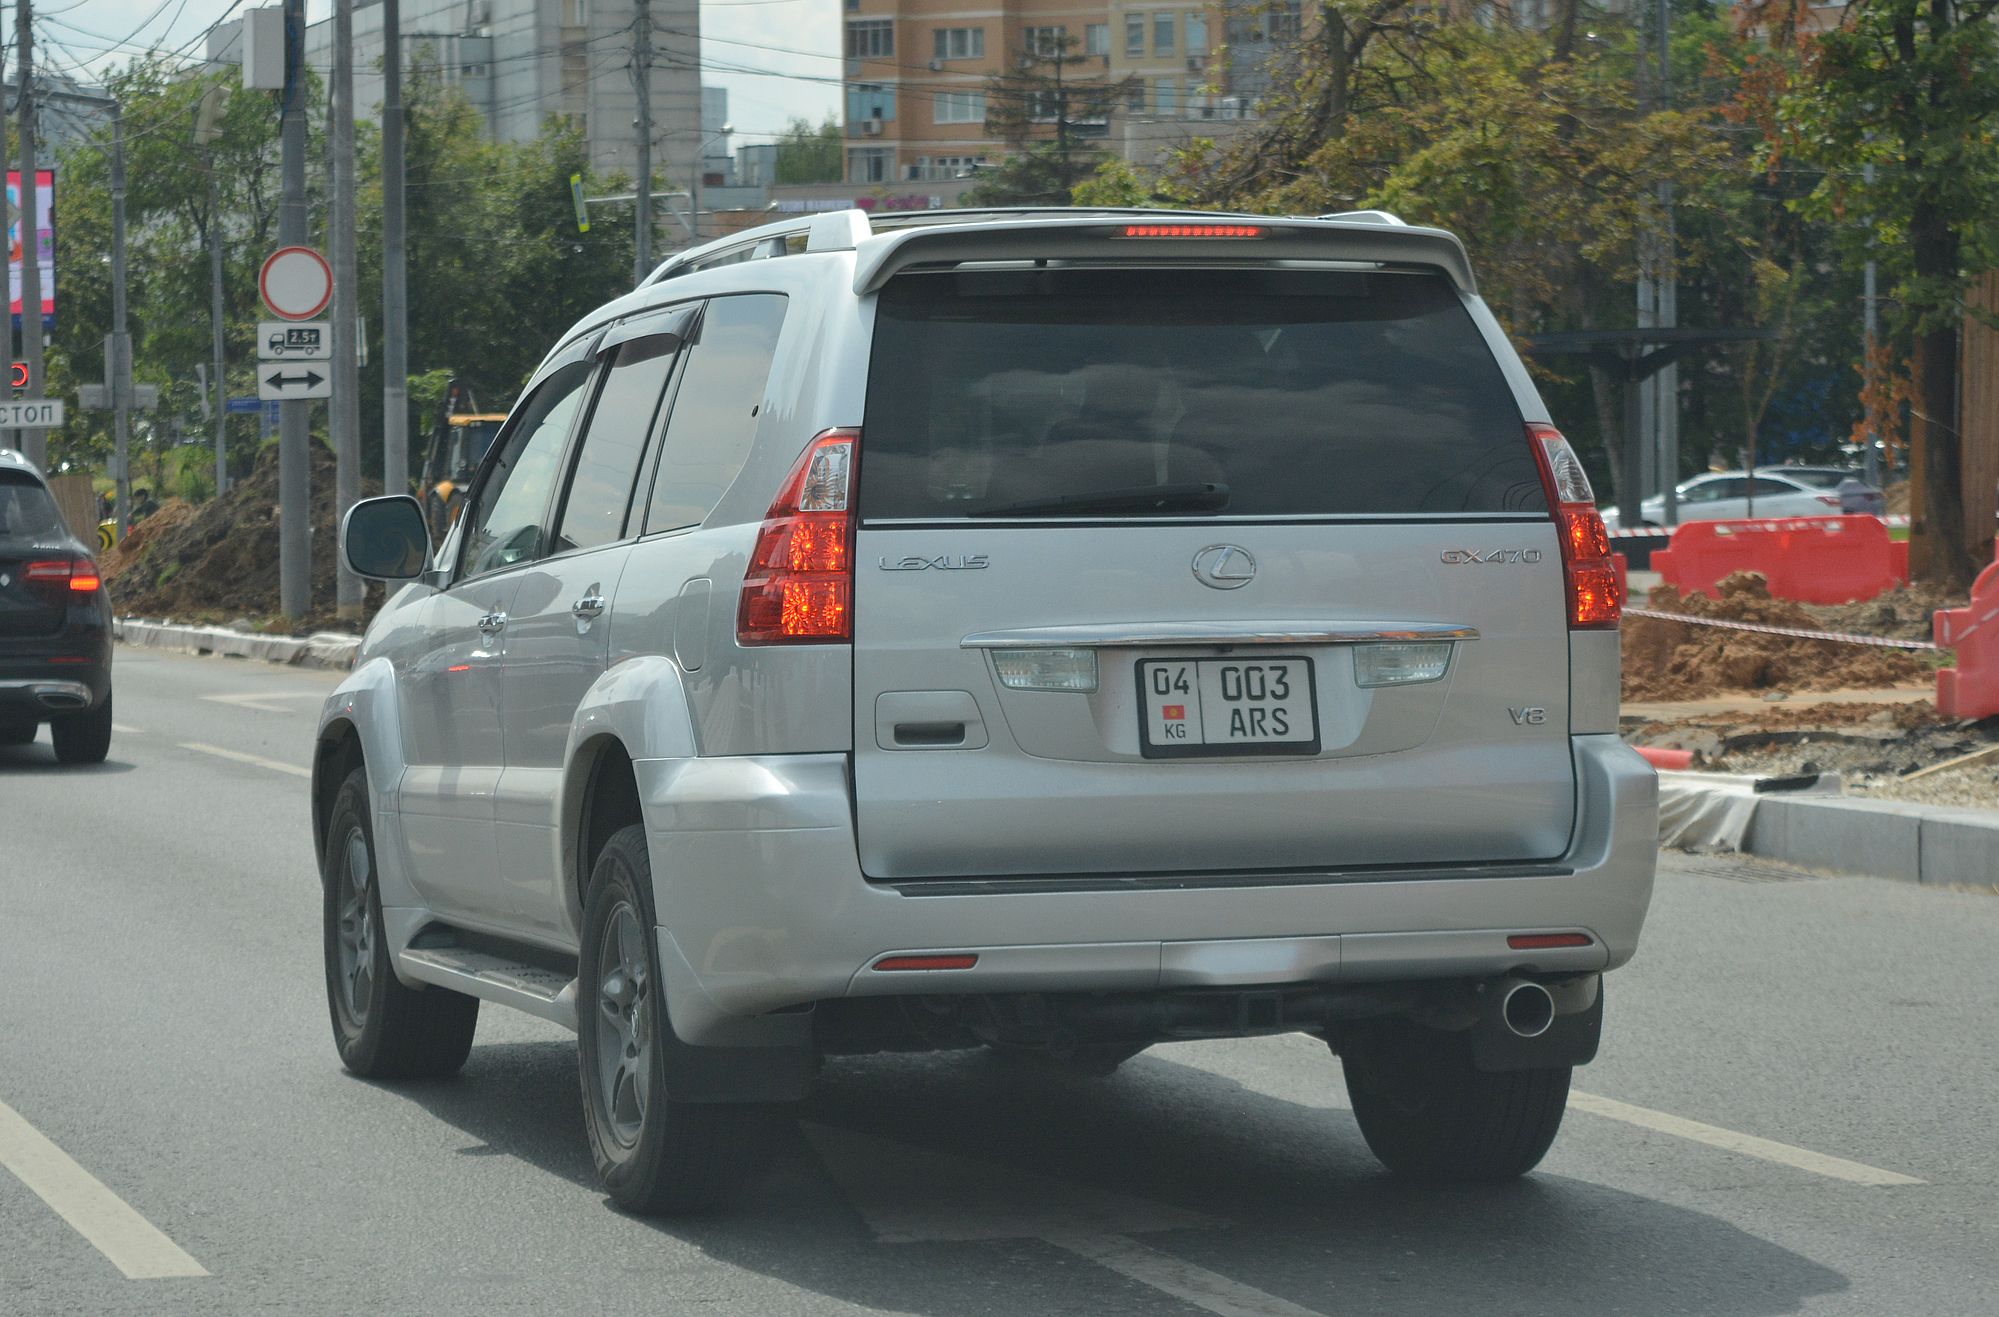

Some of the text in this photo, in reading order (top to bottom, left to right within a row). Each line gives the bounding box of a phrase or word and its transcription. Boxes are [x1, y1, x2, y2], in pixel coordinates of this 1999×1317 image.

[879, 555, 990, 571] LEXUS
[1152, 667, 1190, 695] 04
[1220, 666, 1290, 701] 003
[1229, 707, 1290, 737] ARS
[1507, 707, 1546, 726] V8
[1164, 723, 1186, 739] KG
